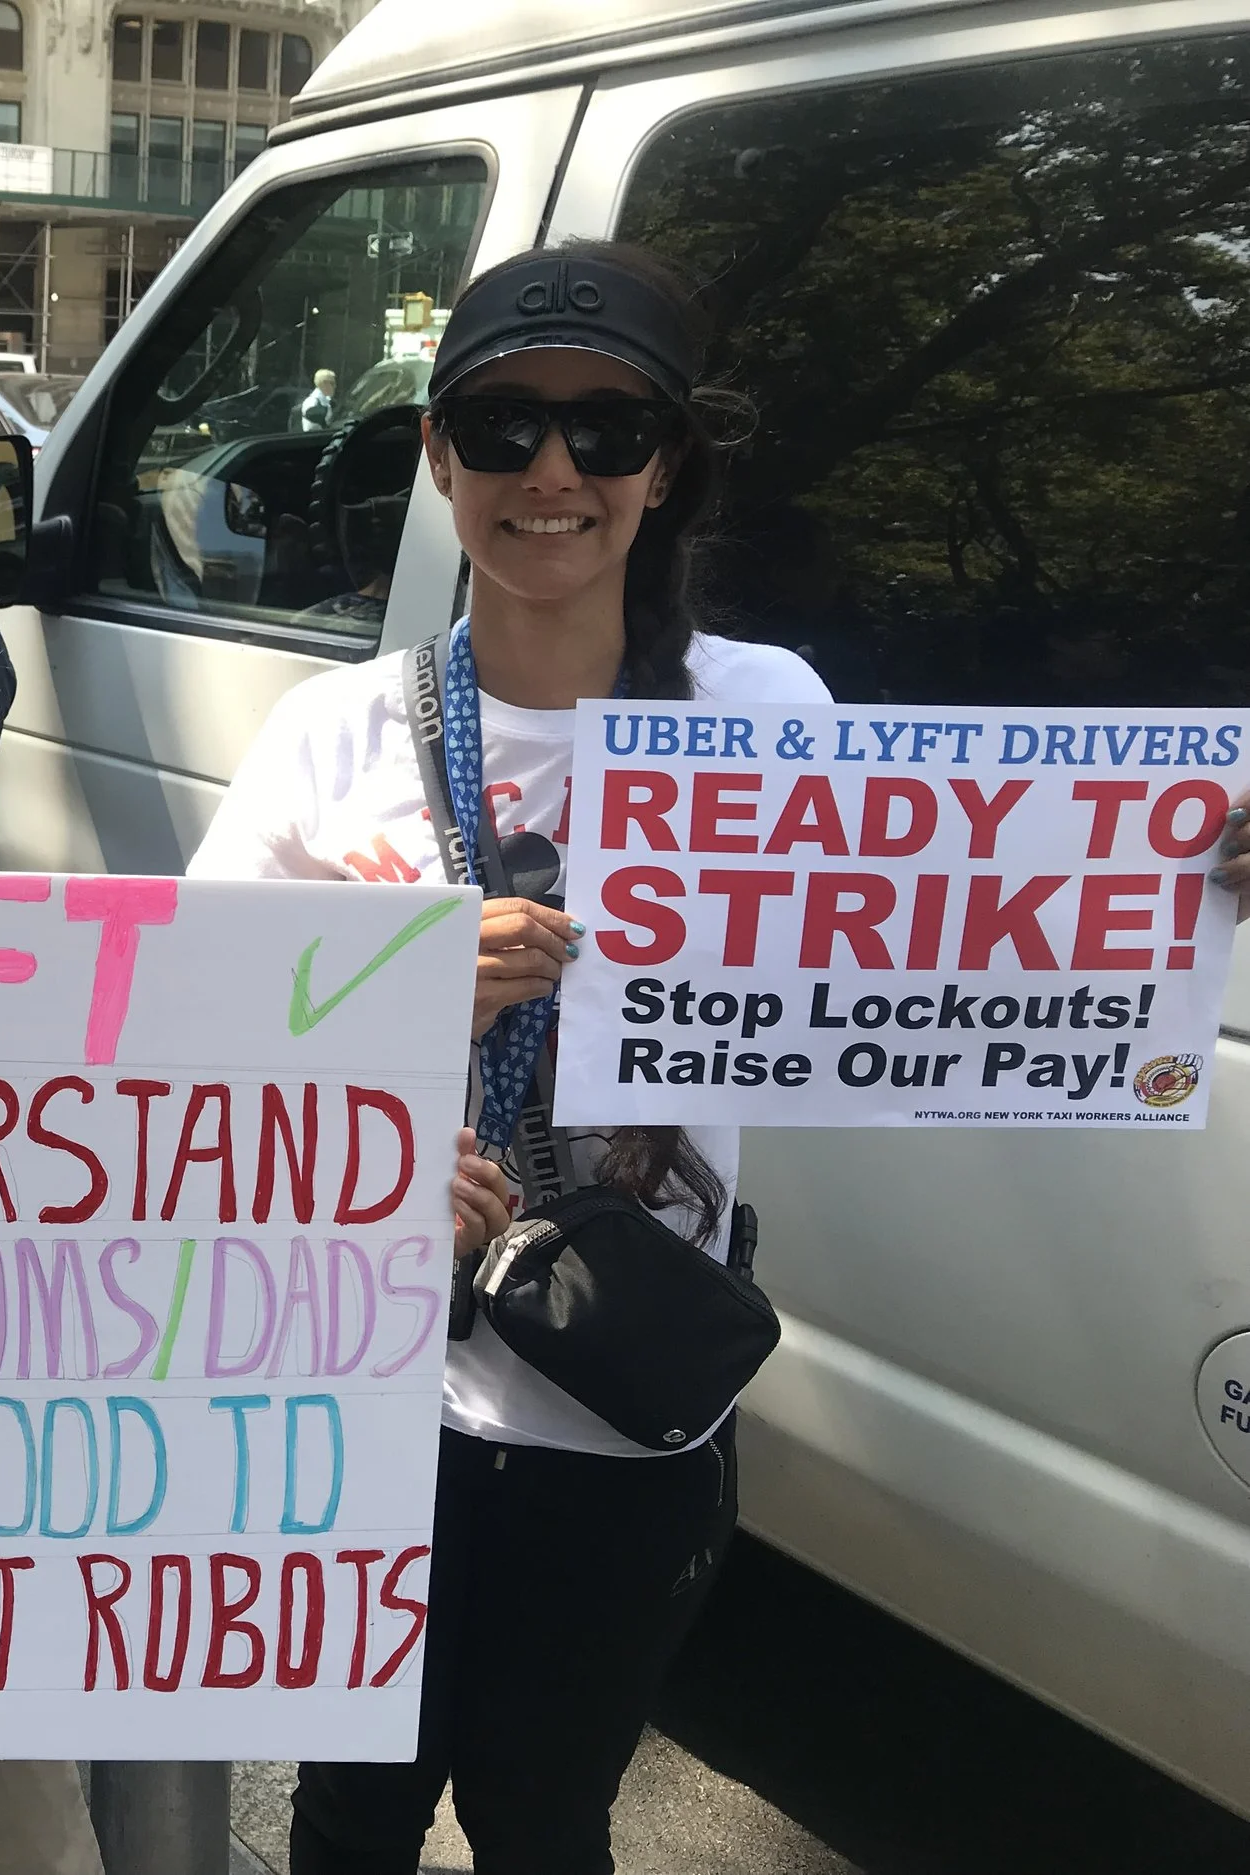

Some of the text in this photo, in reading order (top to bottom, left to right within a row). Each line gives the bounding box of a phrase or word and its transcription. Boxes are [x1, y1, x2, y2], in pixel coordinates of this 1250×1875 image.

[516, 259, 605, 316] alo
[603, 714, 1242, 767] UBER & LYFT DRIVERS
[600, 769, 1230, 859] READY TO
[596, 865, 1204, 971] STRIKE!
[621, 977, 1156, 1039] Stop Lockouts!
[617, 1037, 812, 1087] Raise
[837, 1042, 963, 1088] Our
[981, 1042, 1131, 1101] Pay!
[914, 1110, 1190, 1123] NYTWA.ORG NEW YORK TAXI WORKERS ALLIANCE
[209, 1393, 345, 1535] TO
[77, 1546, 432, 1692] ROBOTS
